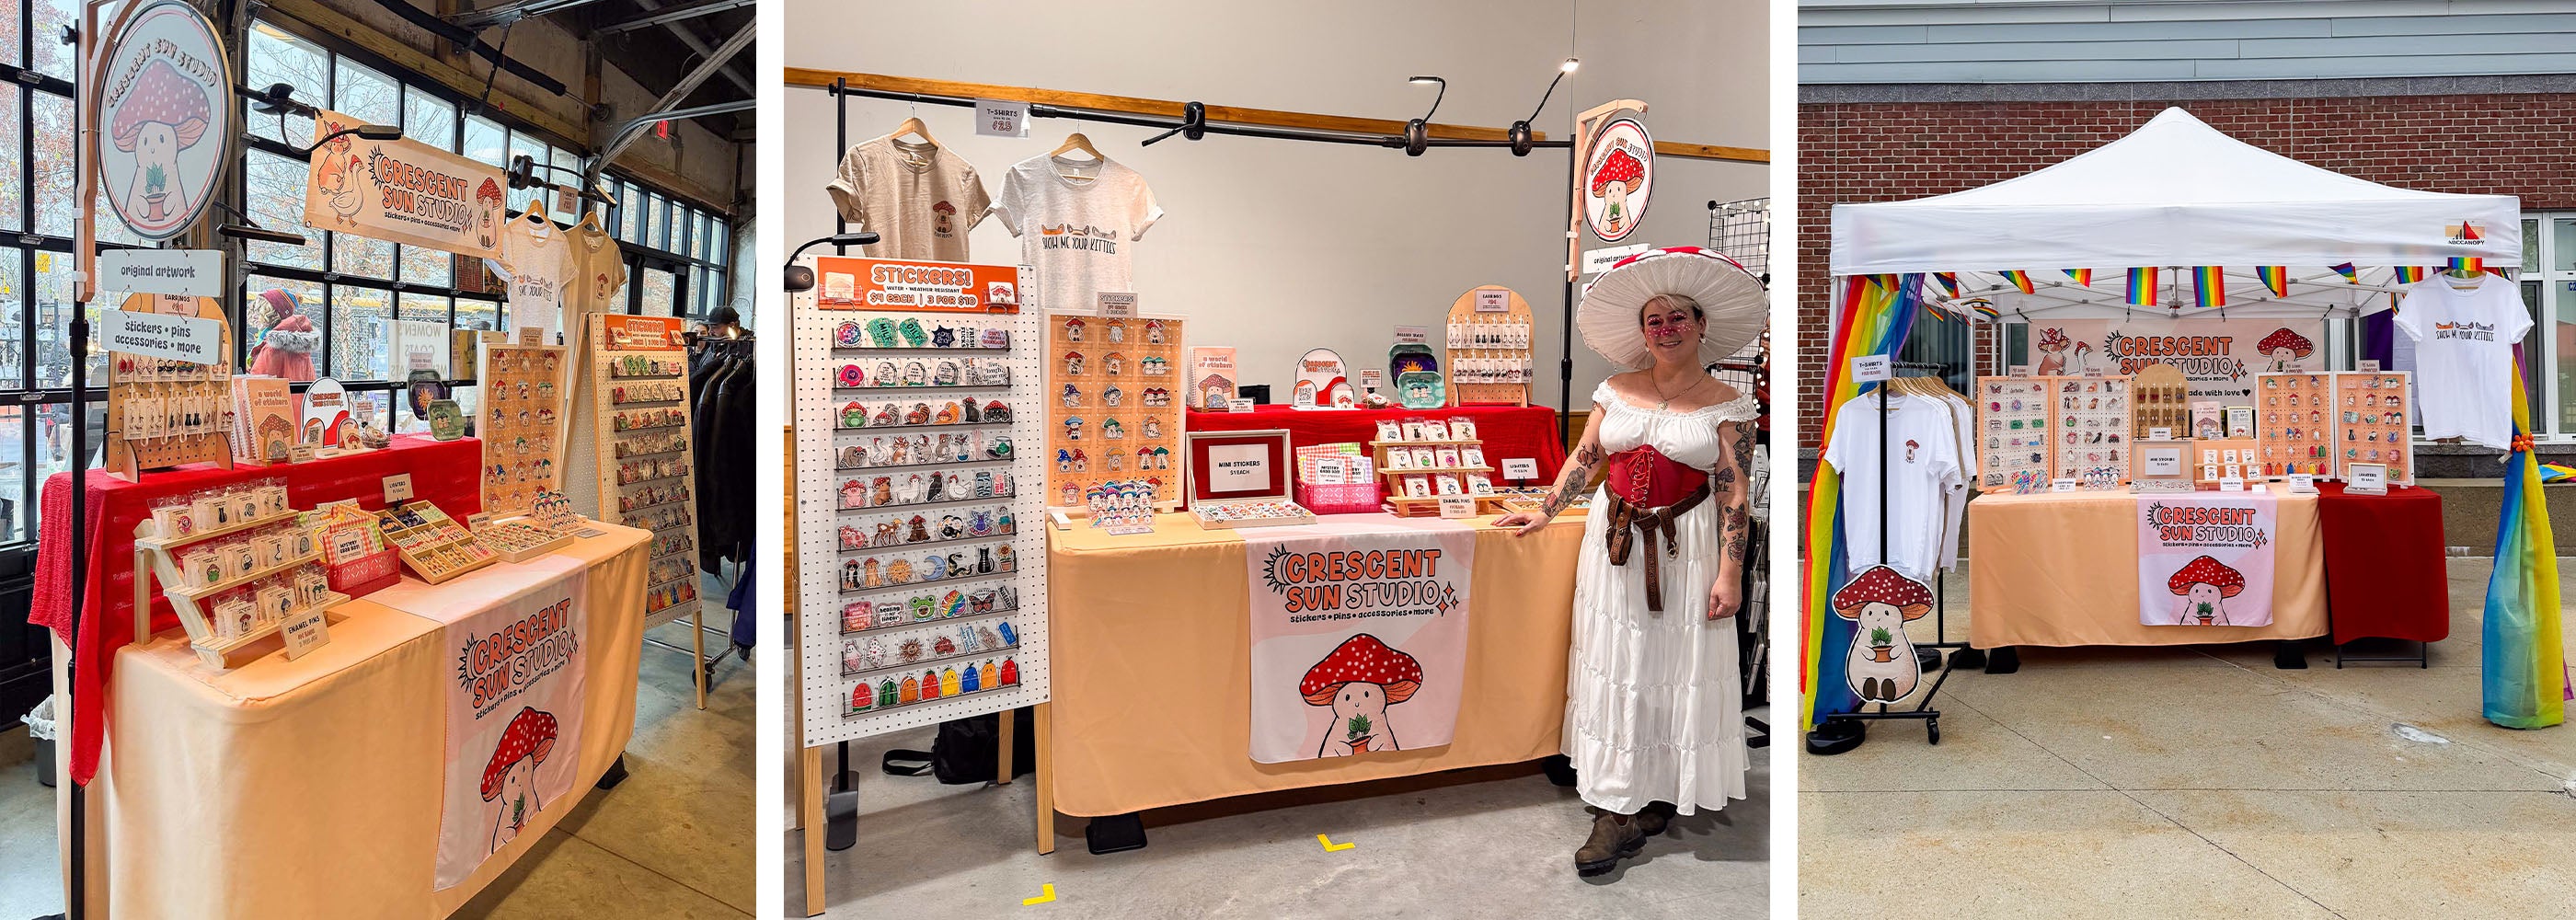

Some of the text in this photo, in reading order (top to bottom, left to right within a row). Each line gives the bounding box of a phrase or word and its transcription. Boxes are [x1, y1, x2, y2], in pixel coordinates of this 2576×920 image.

[107, 39, 217, 108] CRESCENT SUN STUDIO
[987, 109, 1018, 117] T-SHIRTS
[993, 121, 1012, 132] $25
[1590, 137, 1649, 176] CRESCENT SUN STUDIO
[381, 156, 467, 201] CRESCENT
[382, 186, 467, 224] SUN STUDIO
[385, 212, 407, 221] stickers
[410, 216, 420, 224] pins
[424, 220, 450, 230] accessories
[1061, 236, 1069, 248] ME
[1073, 237, 1088, 249] YOUR
[1090, 238, 1116, 254] KITTIES
[1594, 255, 1613, 264] original
[121, 265, 195, 278] original artwork
[870, 293, 883, 302] $4
[927, 295, 934, 305] 3
[937, 295, 955, 305] FOR
[958, 296, 976, 305] $10
[125, 322, 190, 338] stickers pins
[880, 323, 892, 341] MILF
[115, 335, 201, 354] accessories more
[2120, 337, 2232, 356] CRESCENT
[2160, 507, 2255, 525] CRESCENT
[2159, 526, 2255, 542] SUN STUDIO
[1285, 549, 1441, 583] CRESCENT
[1285, 581, 1440, 613] SUN STUDIO
[288, 620, 308, 634] ENAMEL
[309, 615, 319, 626] PINS
[1290, 614, 1326, 623] stickers
[1333, 612, 1351, 621] pins
[1358, 609, 1408, 618] accessories
[473, 598, 570, 675] CRESCENT
[473, 630, 569, 708] SUN STUDIO
[476, 700, 500, 719] stickers
[503, 691, 517, 702] pins
[554, 660, 566, 671] more
